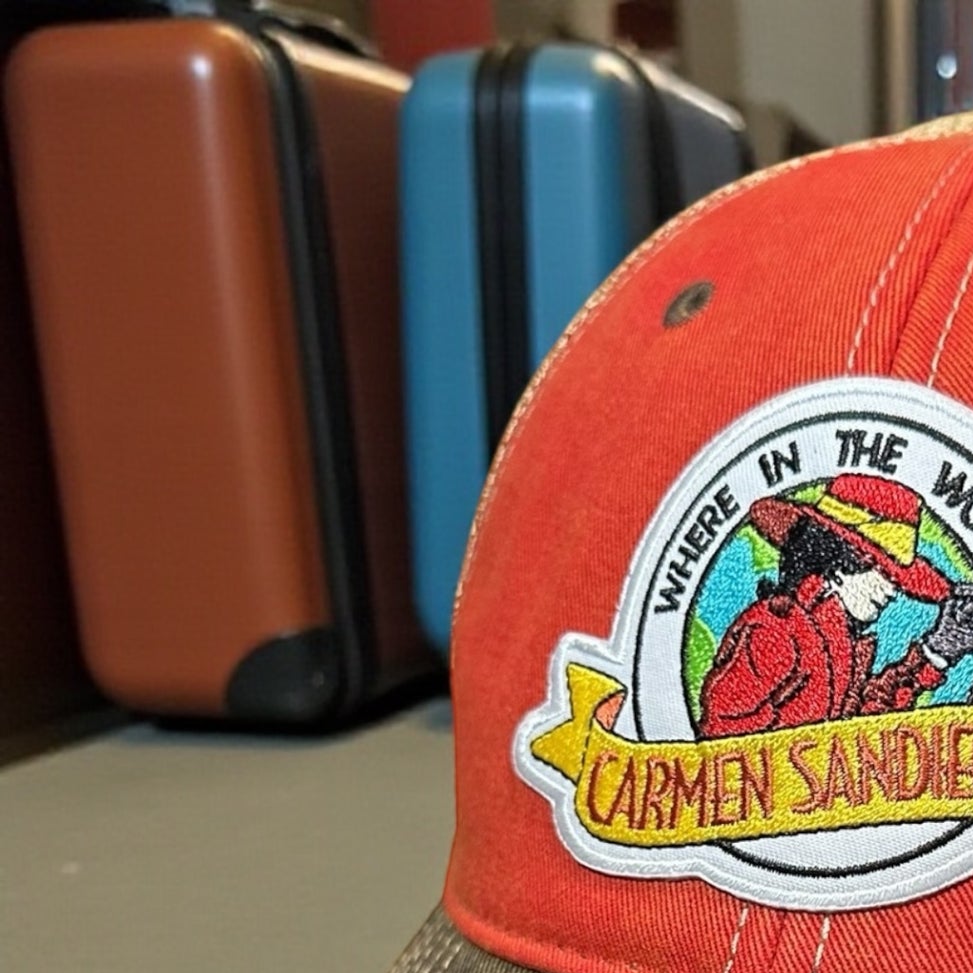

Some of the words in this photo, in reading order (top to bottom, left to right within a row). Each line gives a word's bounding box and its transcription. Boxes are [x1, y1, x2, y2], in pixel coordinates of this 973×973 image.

[654, 489, 740, 615] WHERE
[758, 441, 802, 489] IN
[835, 428, 908, 474] THE
[585, 746, 773, 830] CARMEN
